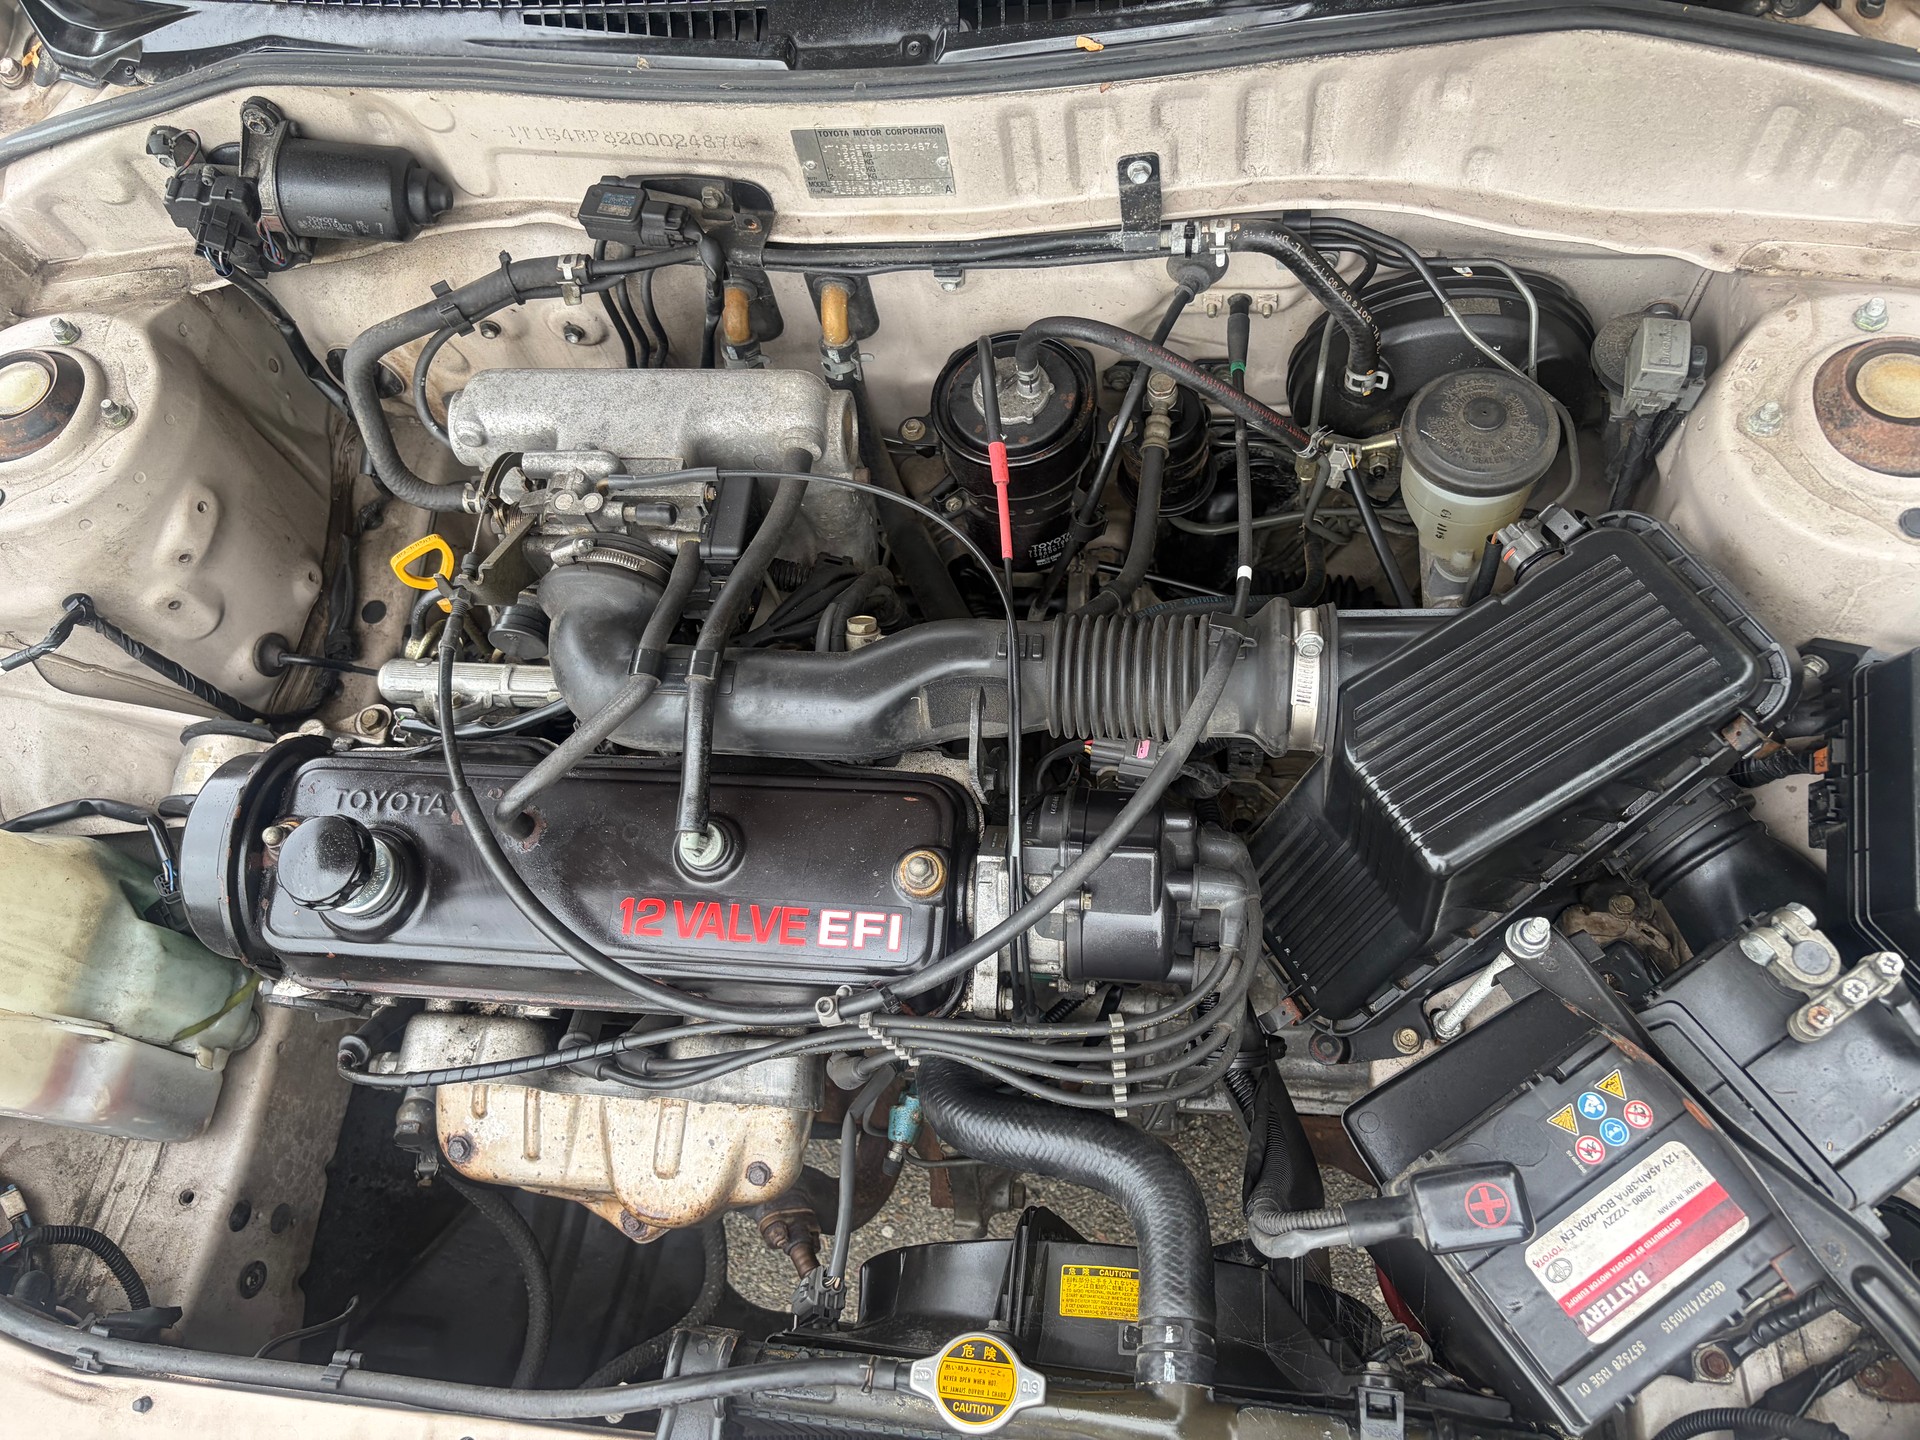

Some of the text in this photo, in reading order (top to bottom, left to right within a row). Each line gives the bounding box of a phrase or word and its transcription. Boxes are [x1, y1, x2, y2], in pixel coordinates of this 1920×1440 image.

[818, 130, 849, 138] TOYOTA
[946, 185, 952, 193] A
[336, 788, 450, 816] TOYOTA
[619, 897, 902, 952] 12 VALVE EFI
[1660, 1149, 1679, 1168] 12V
[1630, 1184, 1655, 1206] 28800
[1681, 1179, 1702, 1197] MADE
[1573, 1197, 1616, 1233] BCI-420A
[1656, 1198, 1677, 1215] SPAIN
[1559, 1228, 1575, 1243] EN
[1642, 1216, 1682, 1249] DISTRIBUTED
[1531, 1243, 1563, 1269] TOYOTA
[1609, 1251, 1635, 1274] TOYOTA
[1099, 1269, 1131, 1278] CAUTION
[1586, 1270, 1611, 1291] MOTOR
[1564, 1287, 1589, 1309] EUROPE
[1576, 1268, 1650, 1331] BATTERY
[961, 1344, 997, 1361] 危険
[1589, 1365, 1613, 1388] 135E
[950, 1386, 966, 1394] JAMAIS
[1576, 1382, 1591, 1397] 01
[953, 1402, 994, 1416] CAUTION
